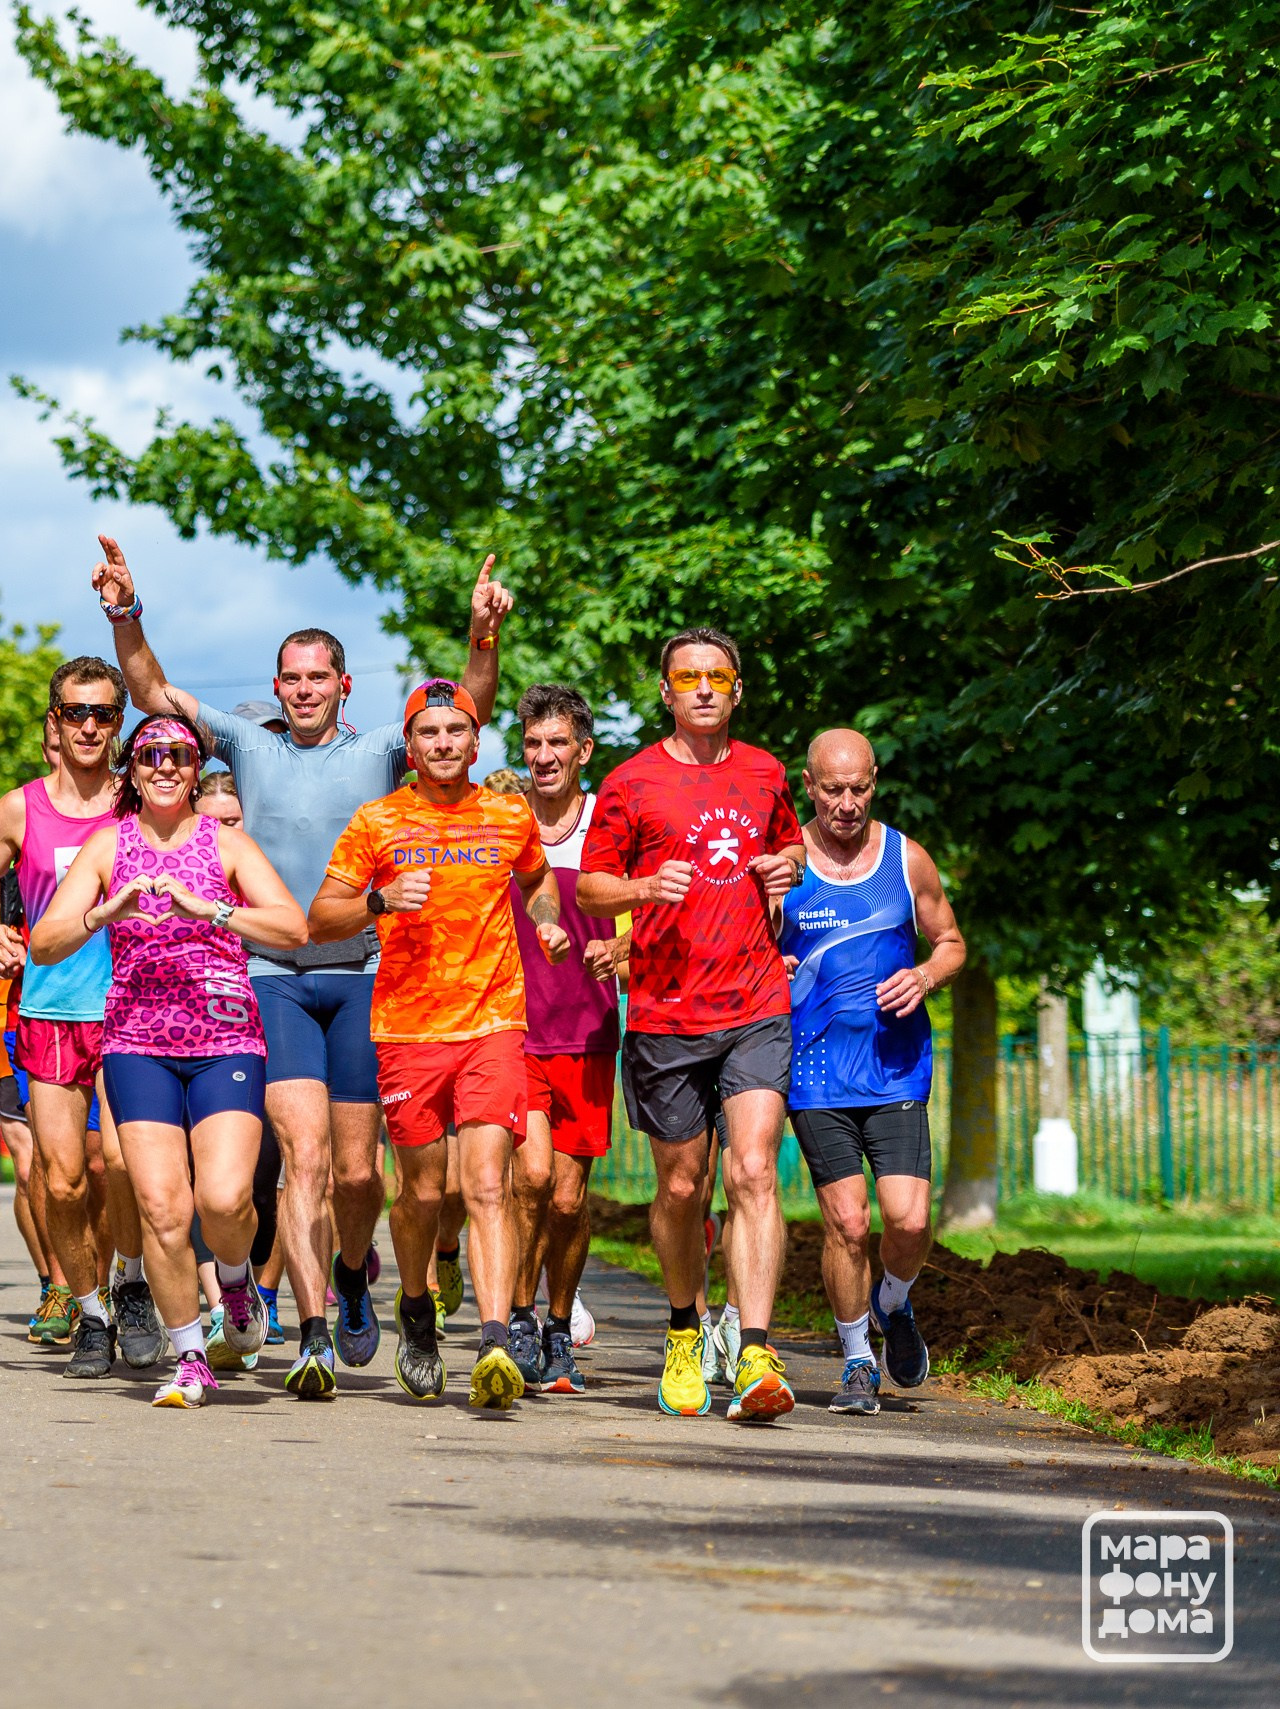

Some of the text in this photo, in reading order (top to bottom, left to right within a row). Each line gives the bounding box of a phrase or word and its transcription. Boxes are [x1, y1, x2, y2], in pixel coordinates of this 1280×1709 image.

[393, 824, 499, 844] GO THE
[686, 808, 758, 844] KLMNRUN
[394, 848, 500, 865] DISTANCE
[798, 907, 836, 920] Russia
[799, 917, 849, 931] Running
